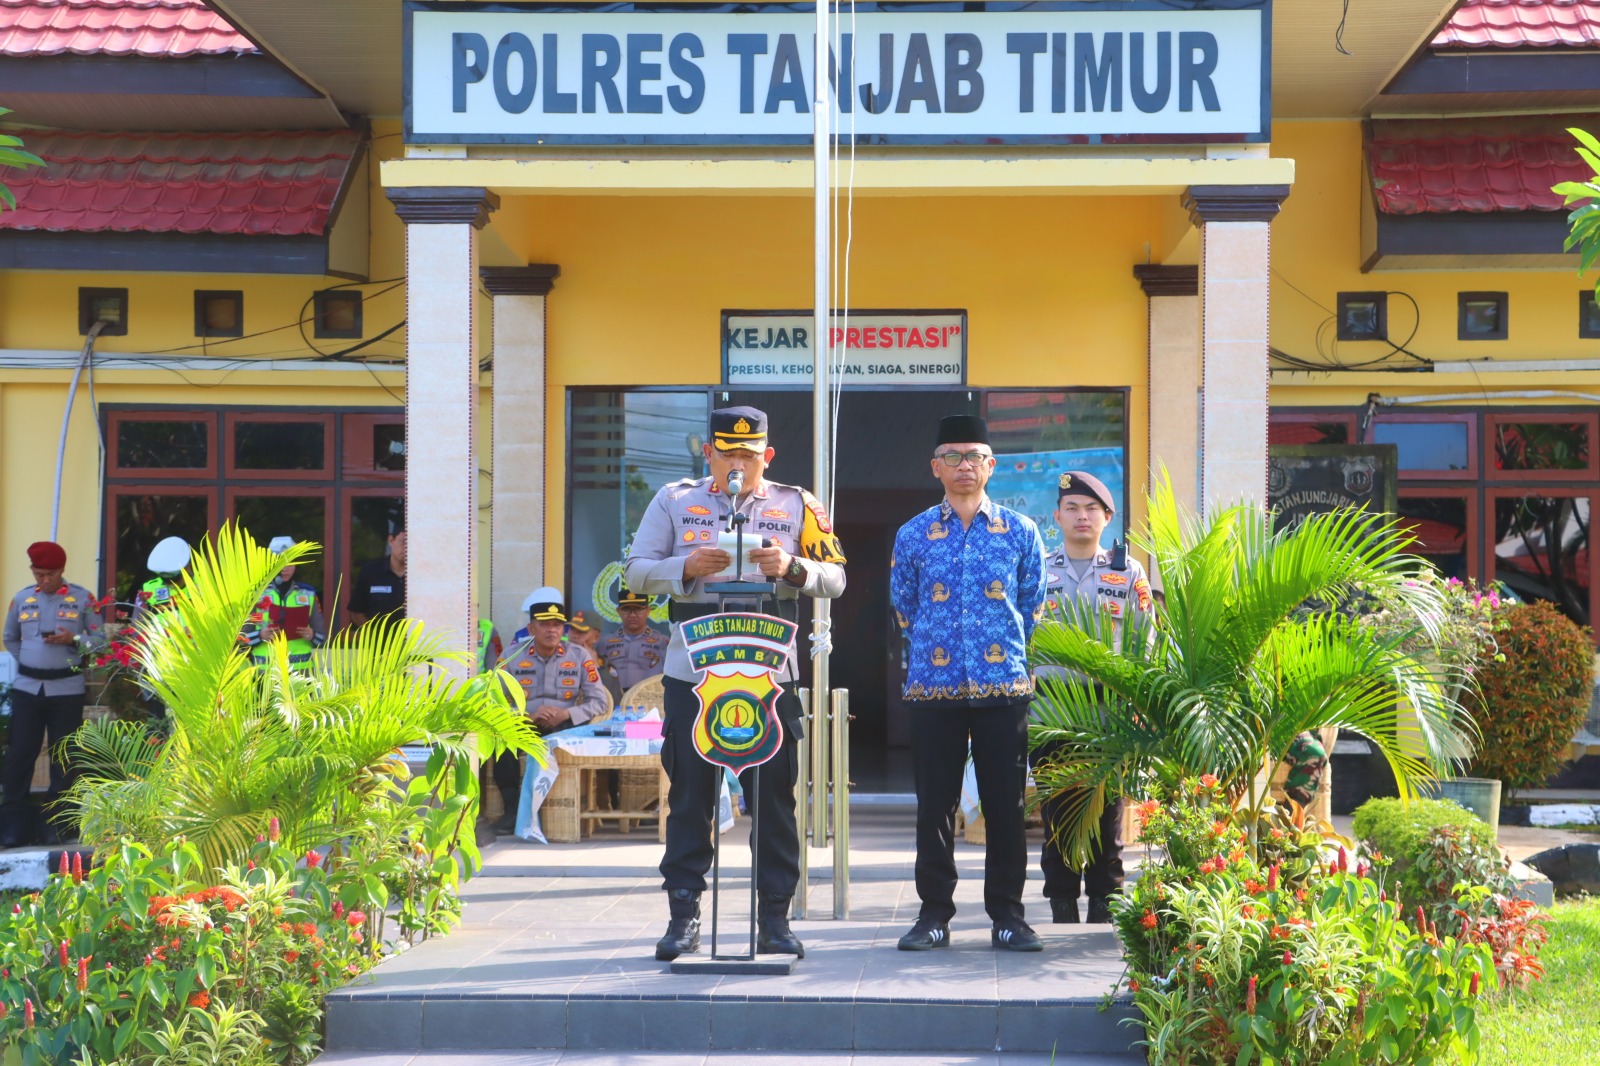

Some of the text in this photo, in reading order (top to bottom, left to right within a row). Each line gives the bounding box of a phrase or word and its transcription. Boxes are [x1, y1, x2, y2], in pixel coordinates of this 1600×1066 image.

[452, 31, 1222, 114] POLRES TANJAB TIMUR
[727, 327, 808, 349] KEJAR
[782, 364, 865, 375] KEHOATAN,
[868, 364, 905, 375] SIAGA,
[909, 363, 960, 375] SINERGI)
[682, 516, 714, 527] WICAK
[758, 521, 791, 533] POLRI
[1097, 587, 1127, 599] POLRI
[693, 618, 785, 639] POLRES TANJAB TIMUR
[699, 649, 779, 665] JAMBI
